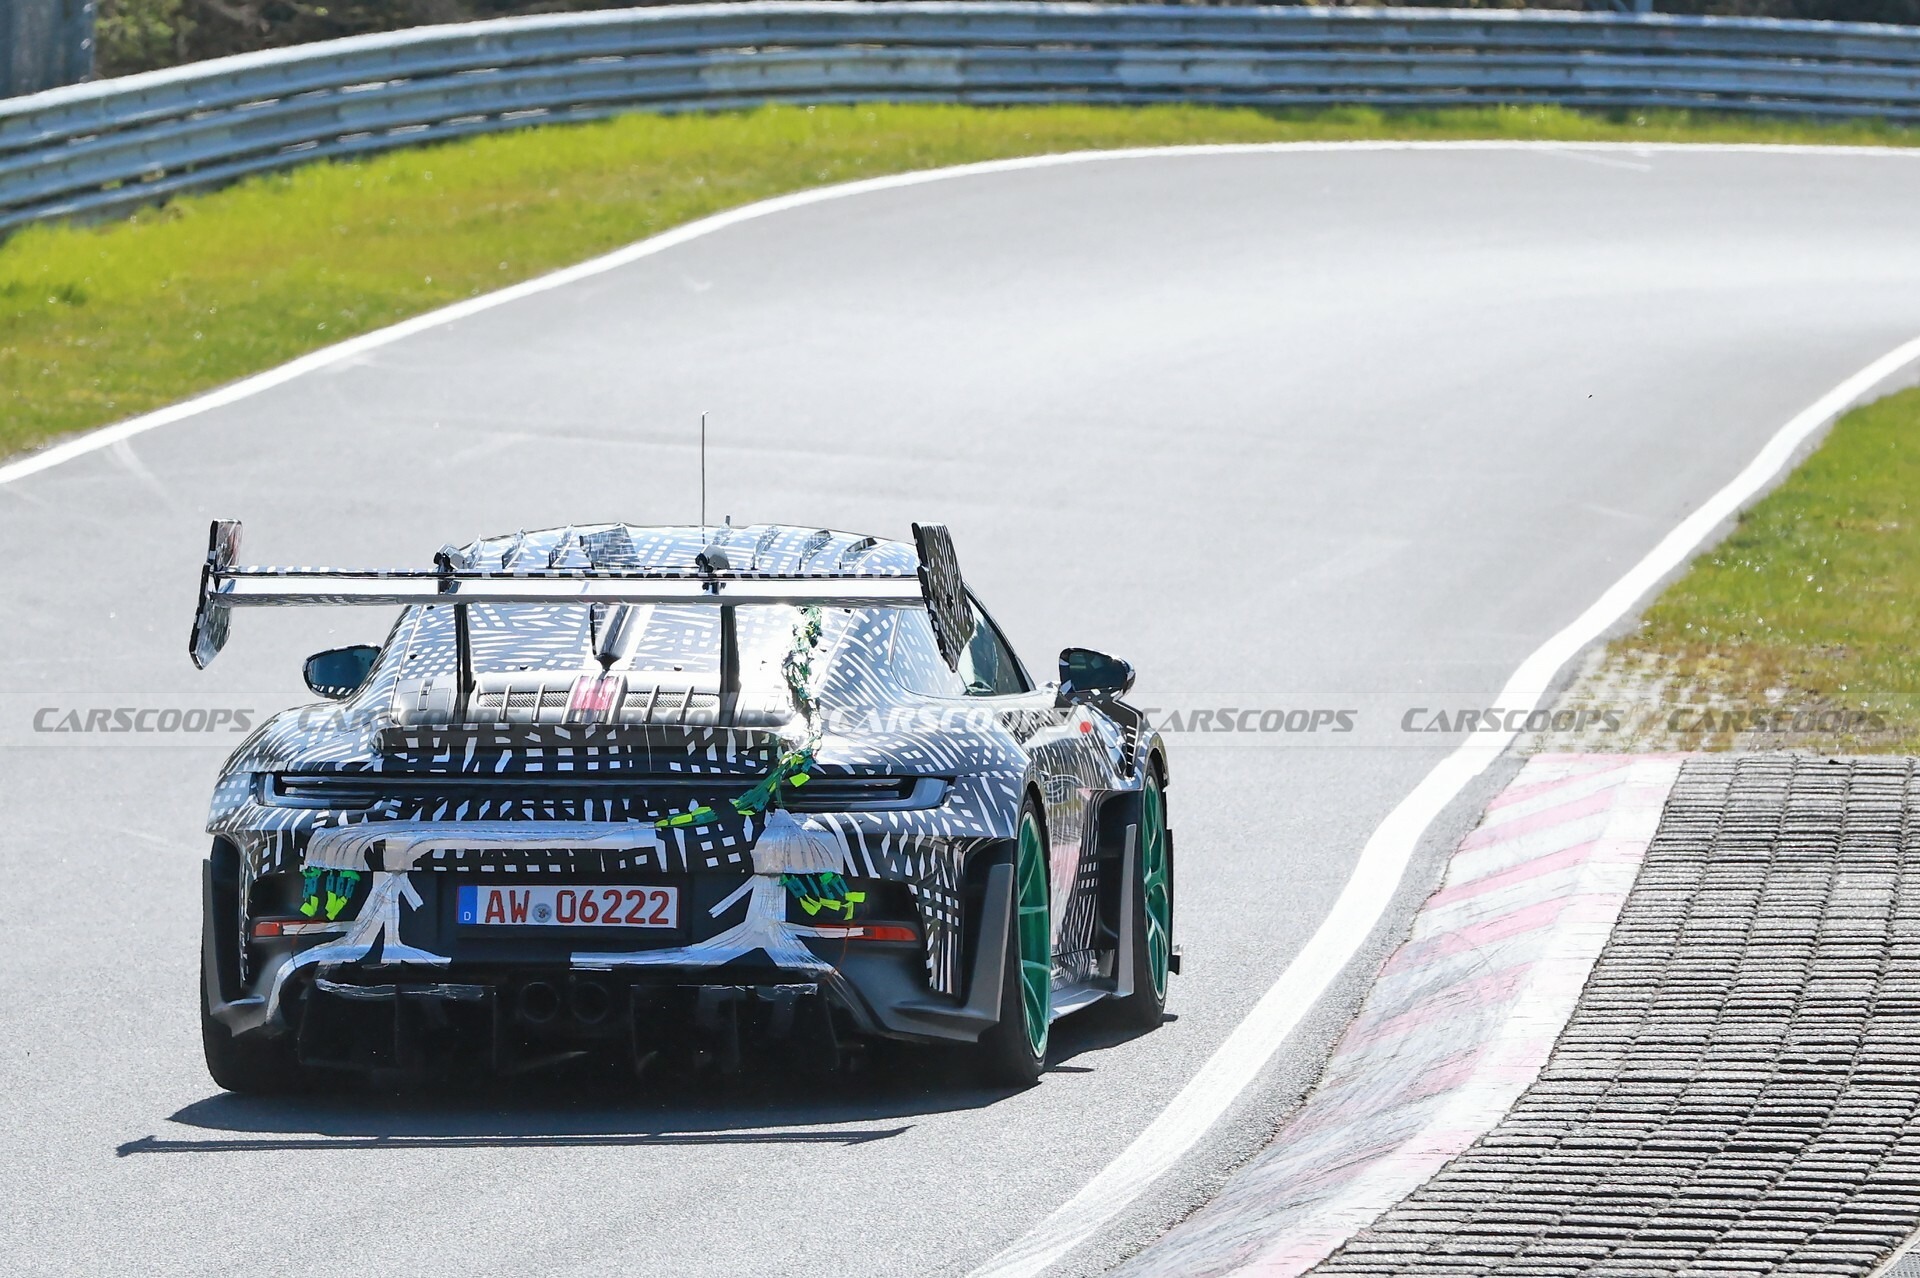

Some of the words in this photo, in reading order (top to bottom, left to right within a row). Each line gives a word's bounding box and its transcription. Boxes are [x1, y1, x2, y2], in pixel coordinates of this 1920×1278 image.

[463, 911, 471, 921] D
[485, 890, 530, 923] AW
[556, 890, 669, 924] 06222
